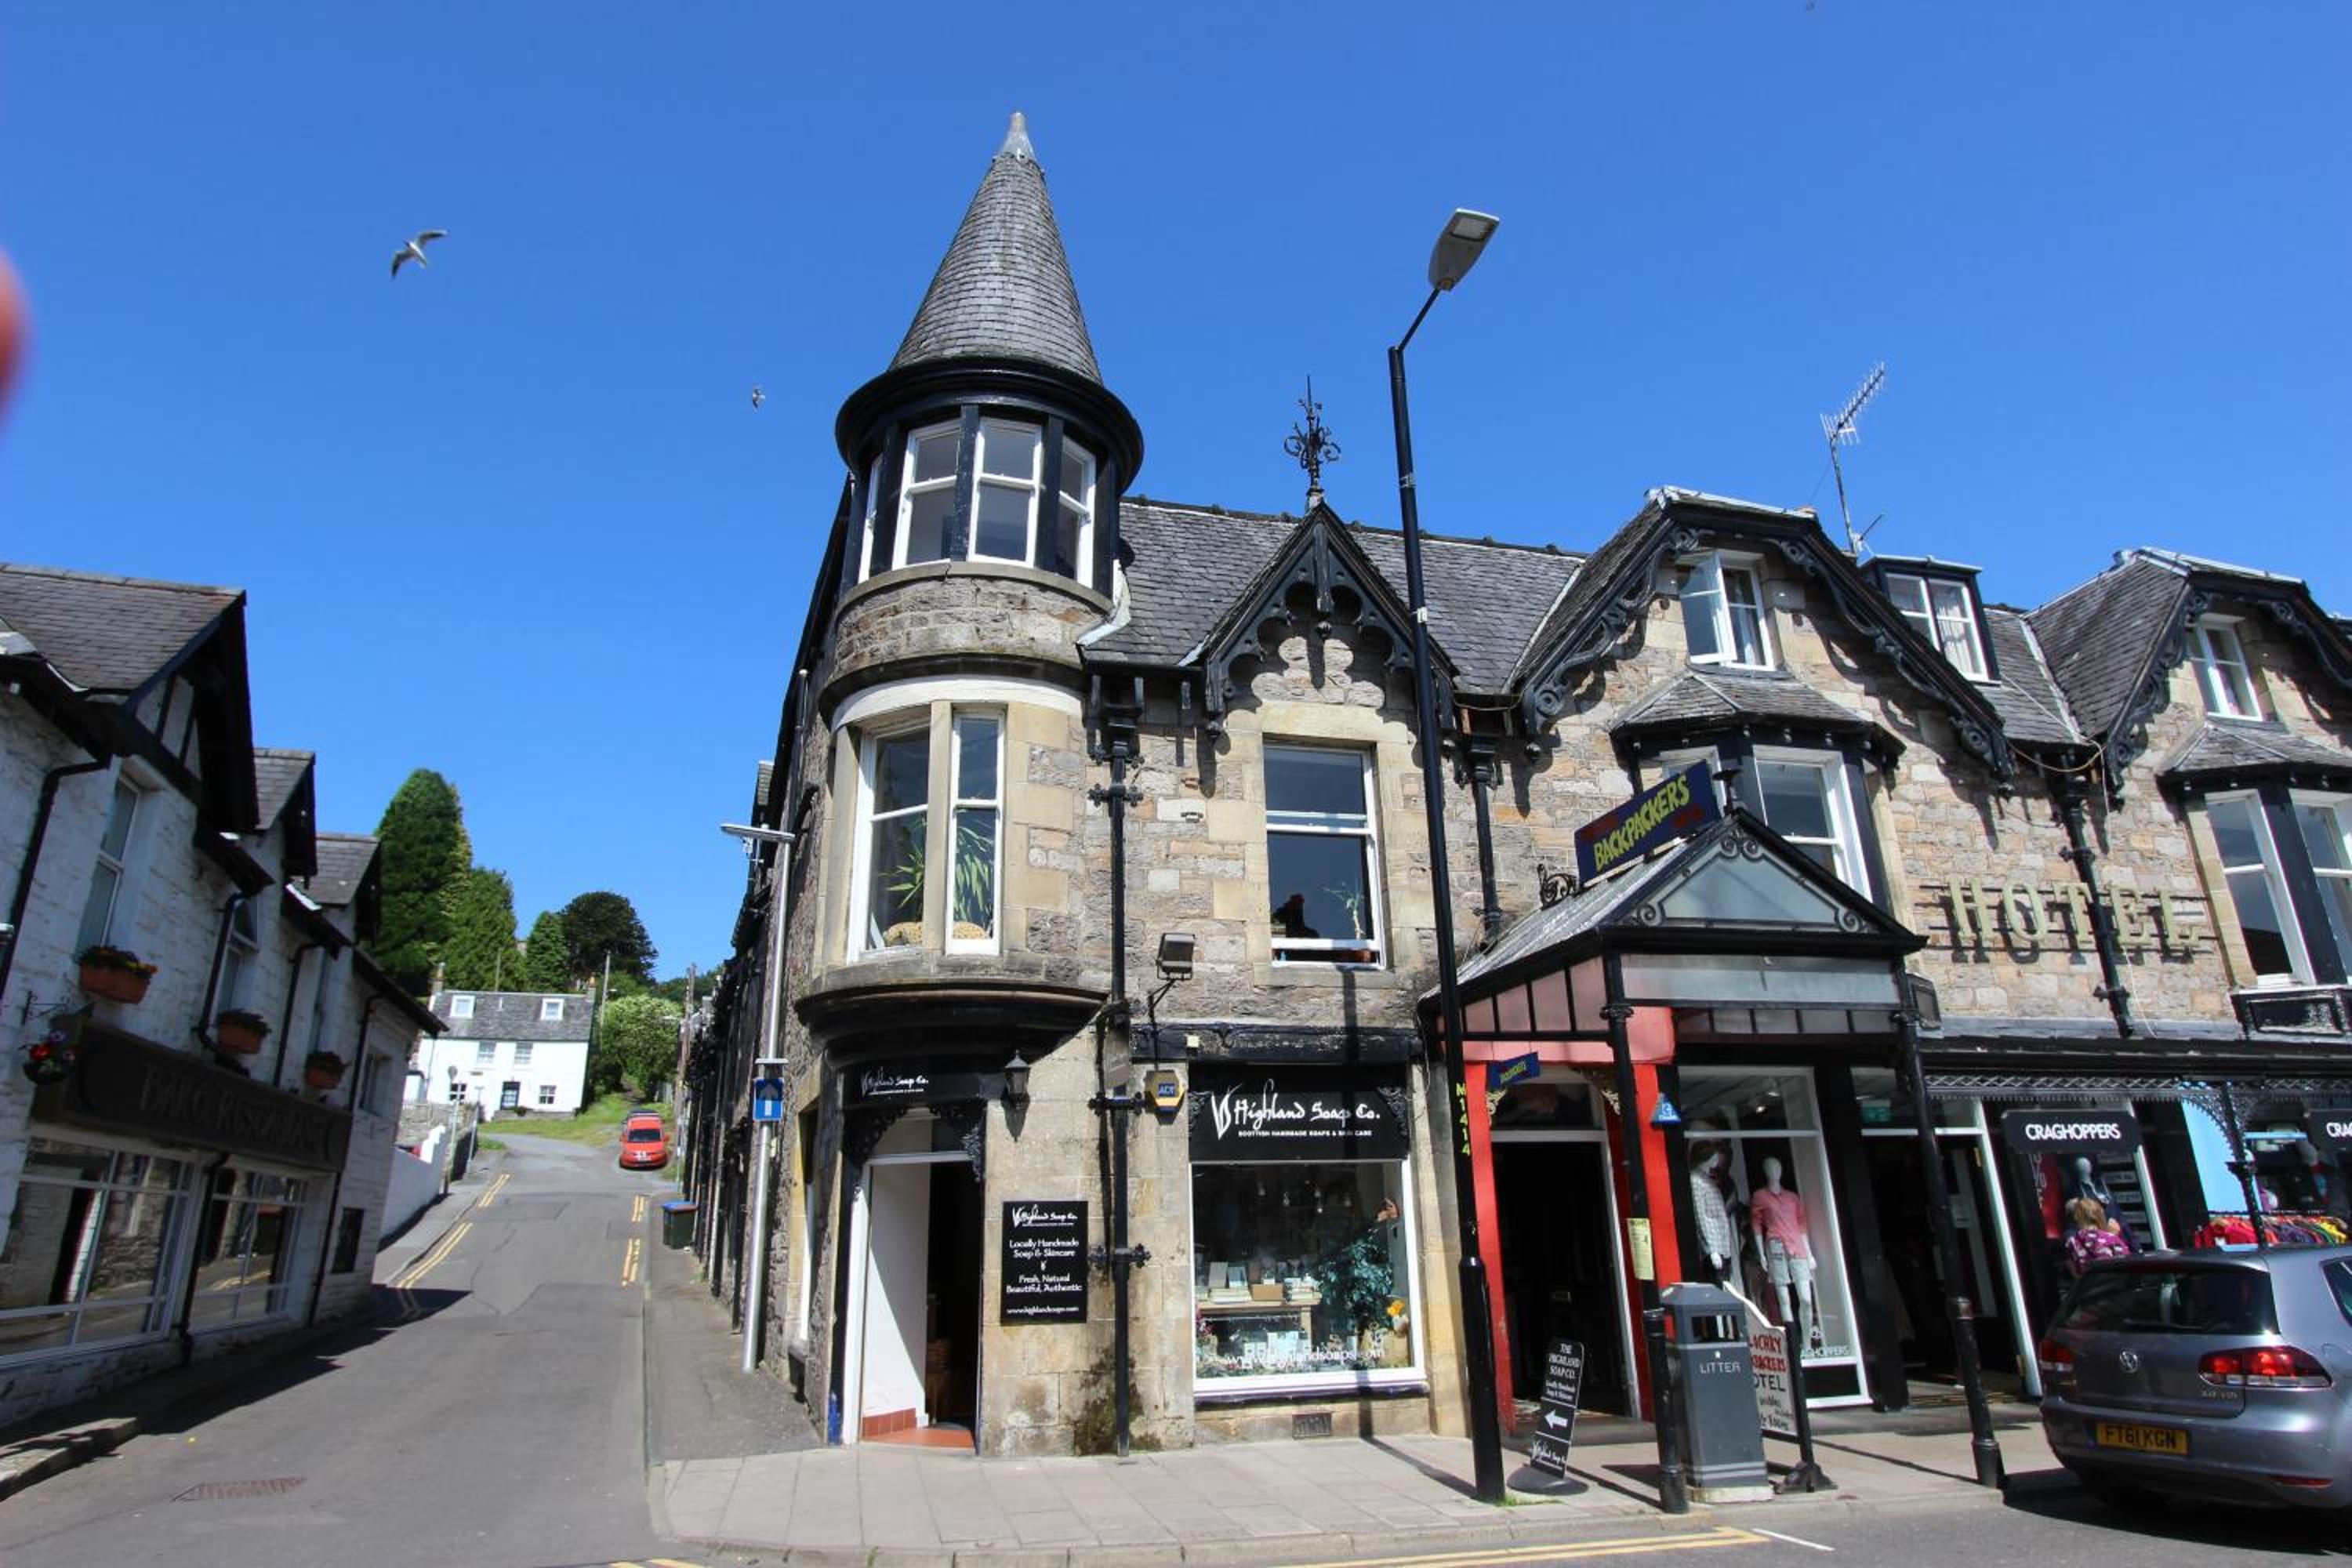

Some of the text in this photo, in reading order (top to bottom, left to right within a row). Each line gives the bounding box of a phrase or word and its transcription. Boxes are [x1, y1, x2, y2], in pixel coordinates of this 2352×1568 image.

[1594, 775, 1690, 872] BACKPACKERS
[1946, 877, 2200, 948] HOTEL
[1234, 1079, 1381, 1131] Highland Soap Co.
[2025, 1123, 2122, 1141] CRAGHOPPERS
[1009, 1237, 1080, 1250] Locally Handmade
[1014, 1249, 1033, 1260] Soap
[1044, 1247, 1076, 1258] Skincare
[1042, 1272, 1070, 1283] Natural
[1044, 1282, 1083, 1293] Authentic
[1699, 1362, 1740, 1374] LITTER
